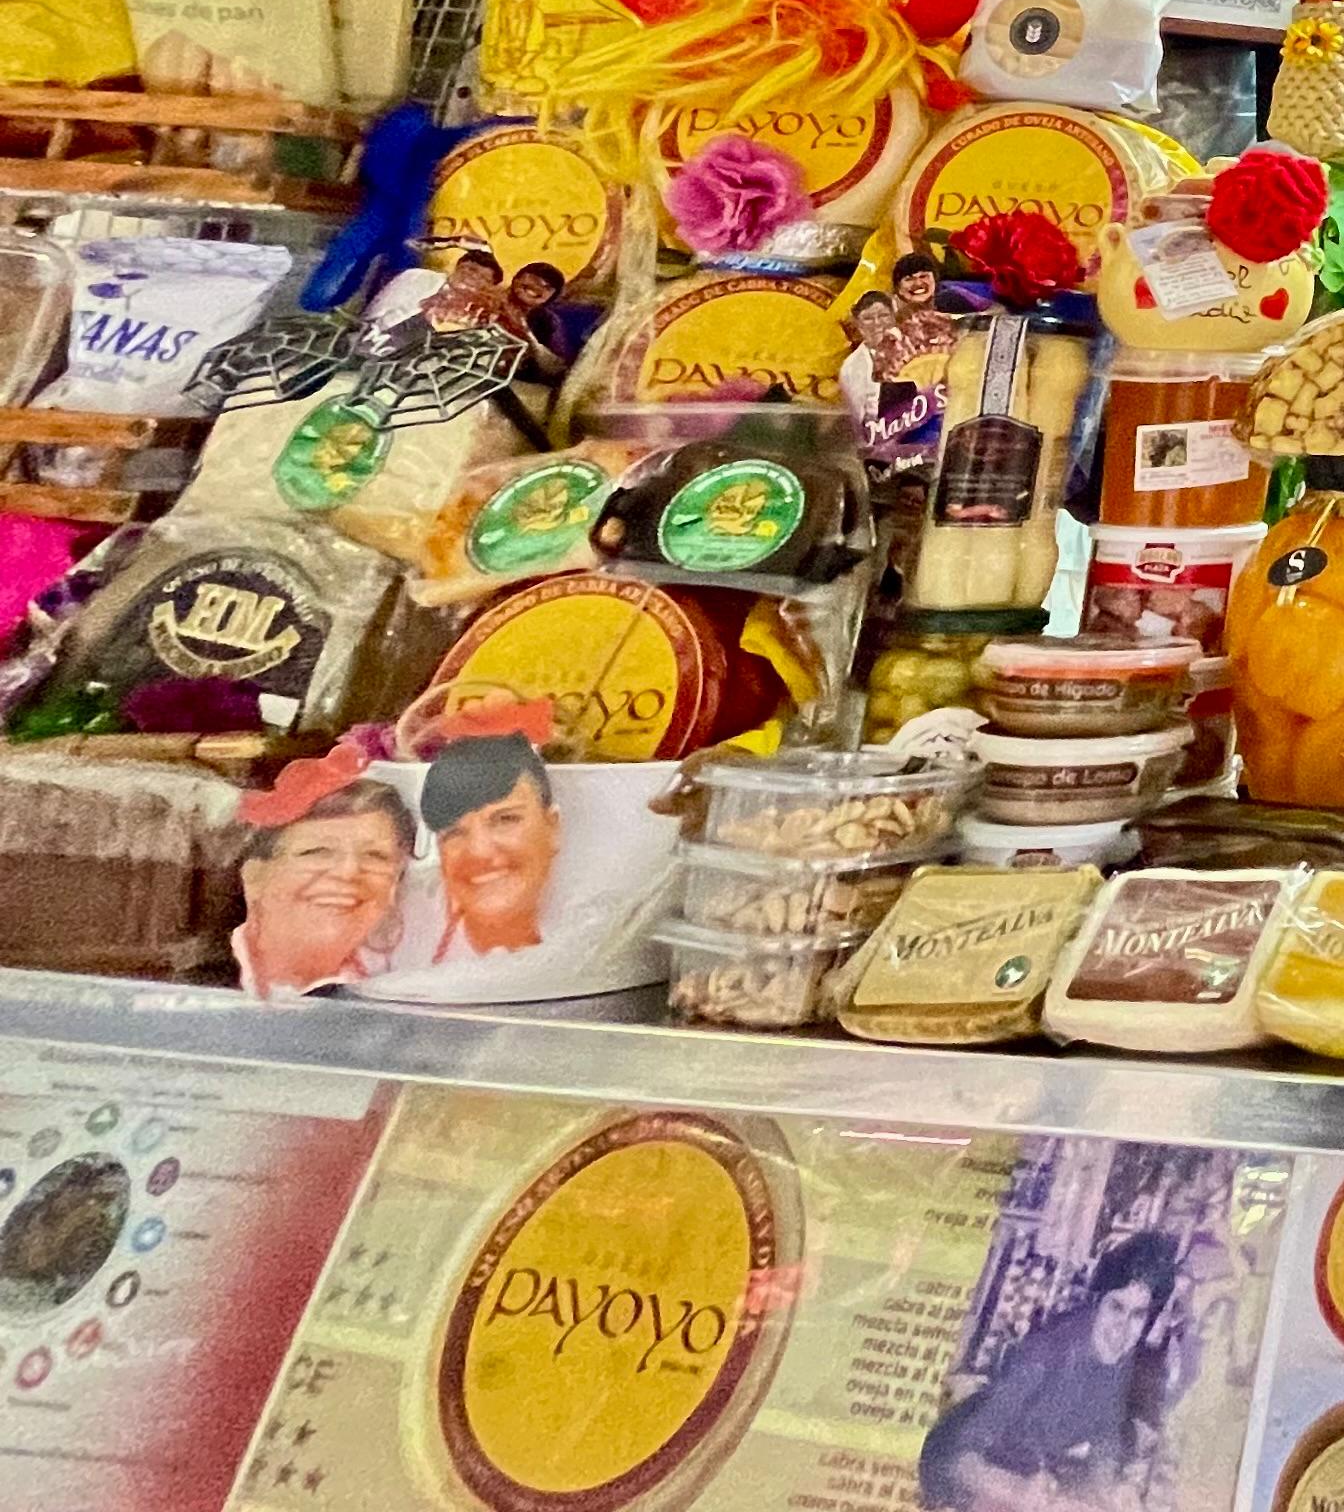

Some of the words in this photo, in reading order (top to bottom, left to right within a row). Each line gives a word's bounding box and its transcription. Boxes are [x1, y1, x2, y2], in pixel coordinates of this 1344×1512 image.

[78, 312, 200, 362] ANAS
[887, 905, 1055, 963] MONTEALVA
[484, 1266, 727, 1374] PAYOYO
